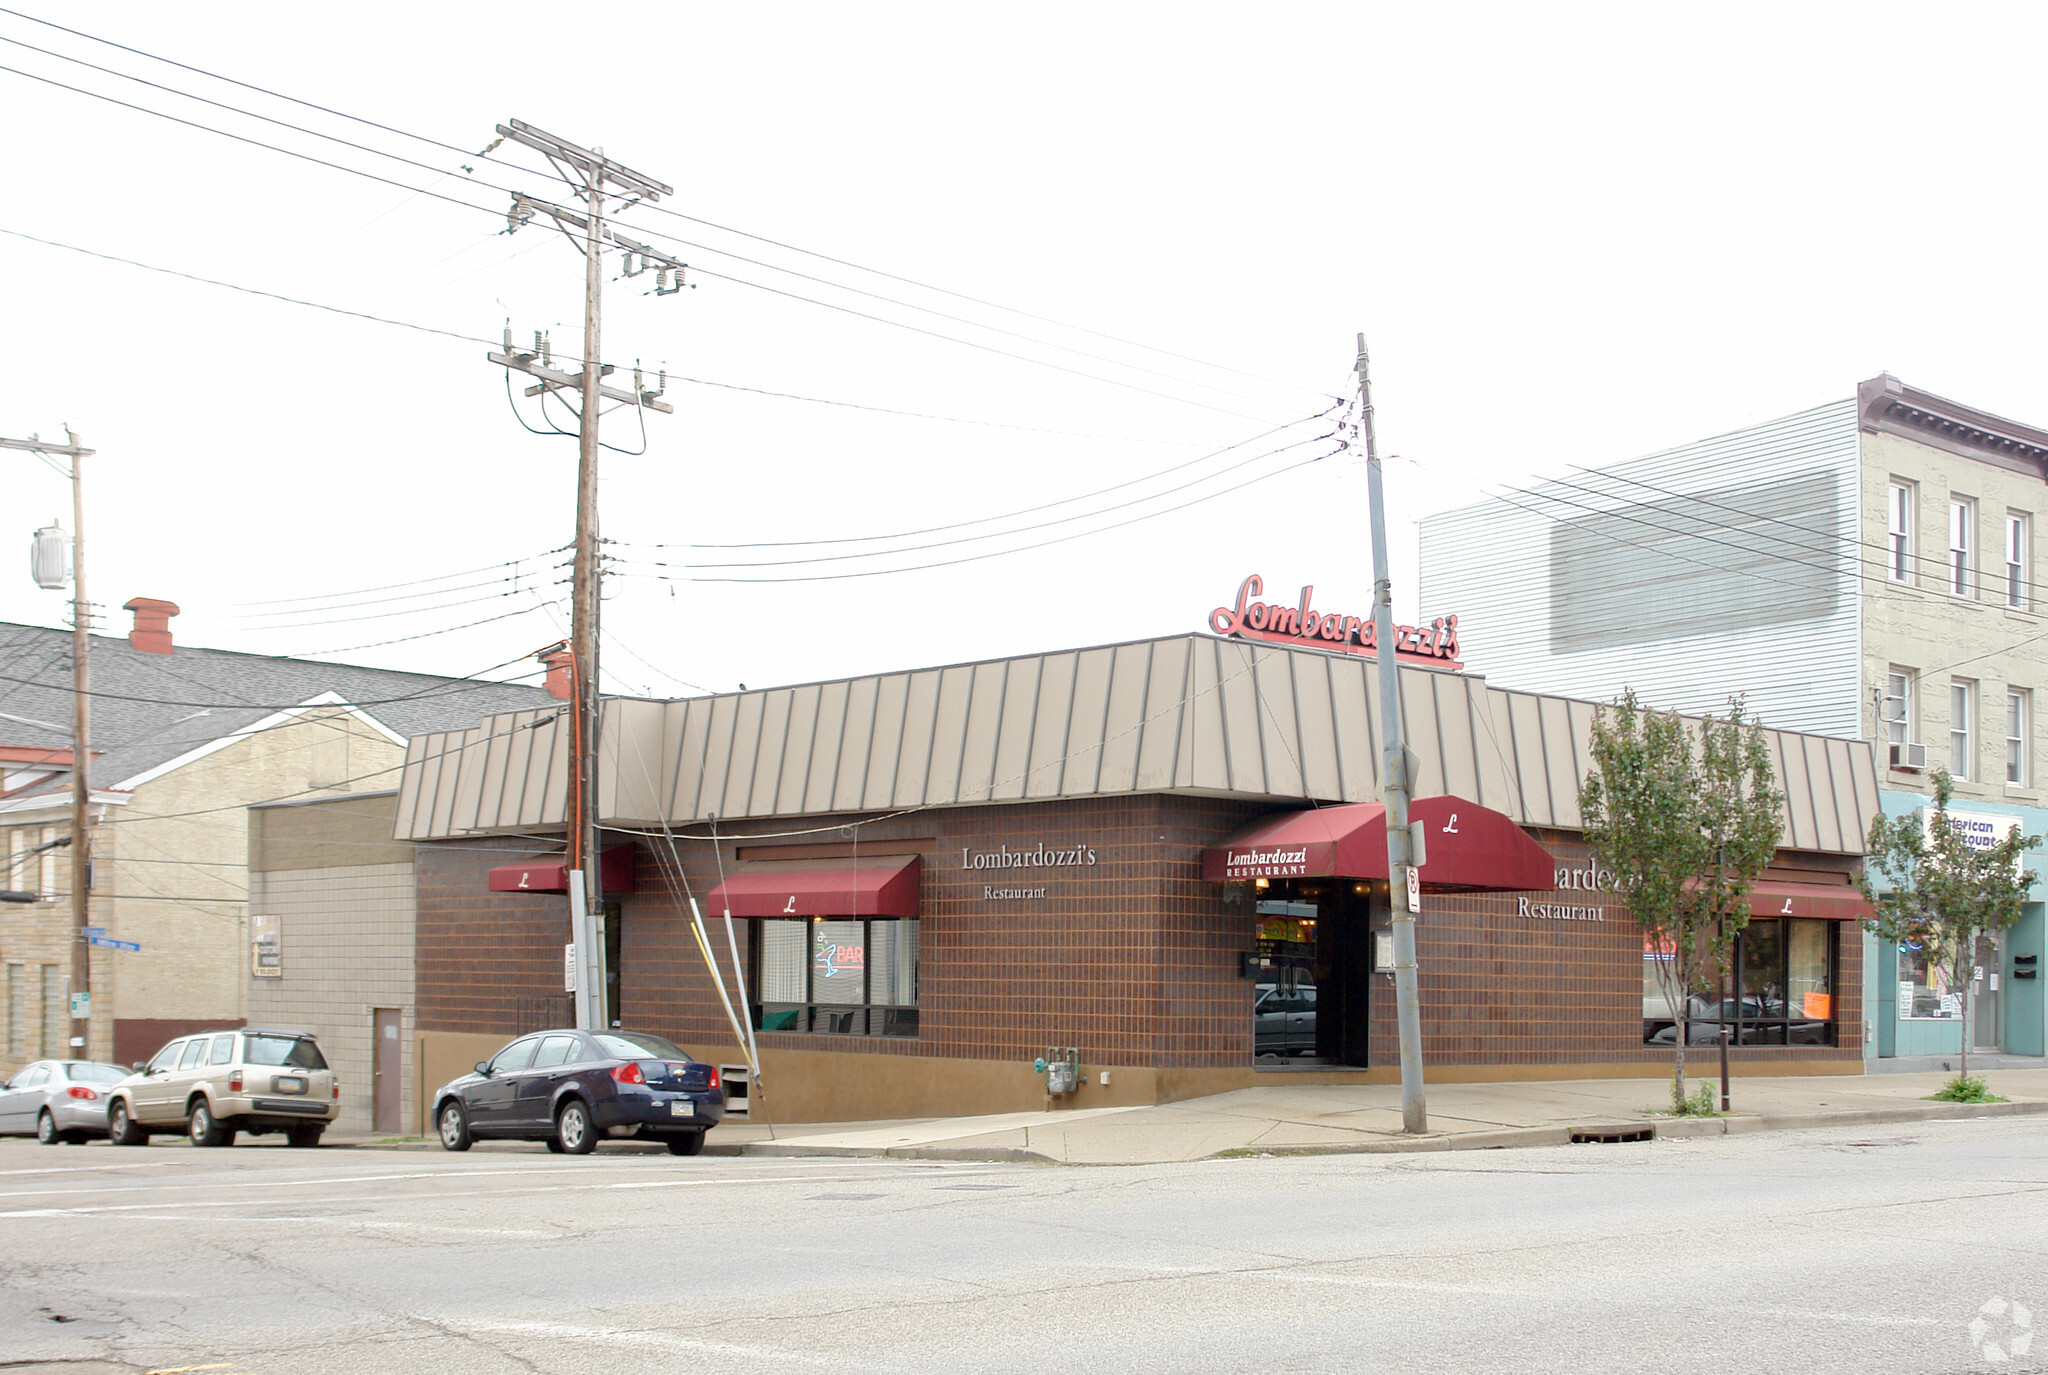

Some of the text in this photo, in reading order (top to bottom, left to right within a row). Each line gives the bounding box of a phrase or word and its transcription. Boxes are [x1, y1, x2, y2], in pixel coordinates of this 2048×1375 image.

[1209, 574, 1460, 659] Lombardzzi's
[1950, 819, 1993, 833] erican
[962, 842, 1096, 870] Lombardozzi's
[1226, 847, 1307, 866] Lombardozzi
[1226, 866, 1306, 877] RESTAURANT
[984, 886, 1046, 900] Restaurant
[1517, 896, 1603, 922] Restaurant
[836, 945, 864, 963] BAR
